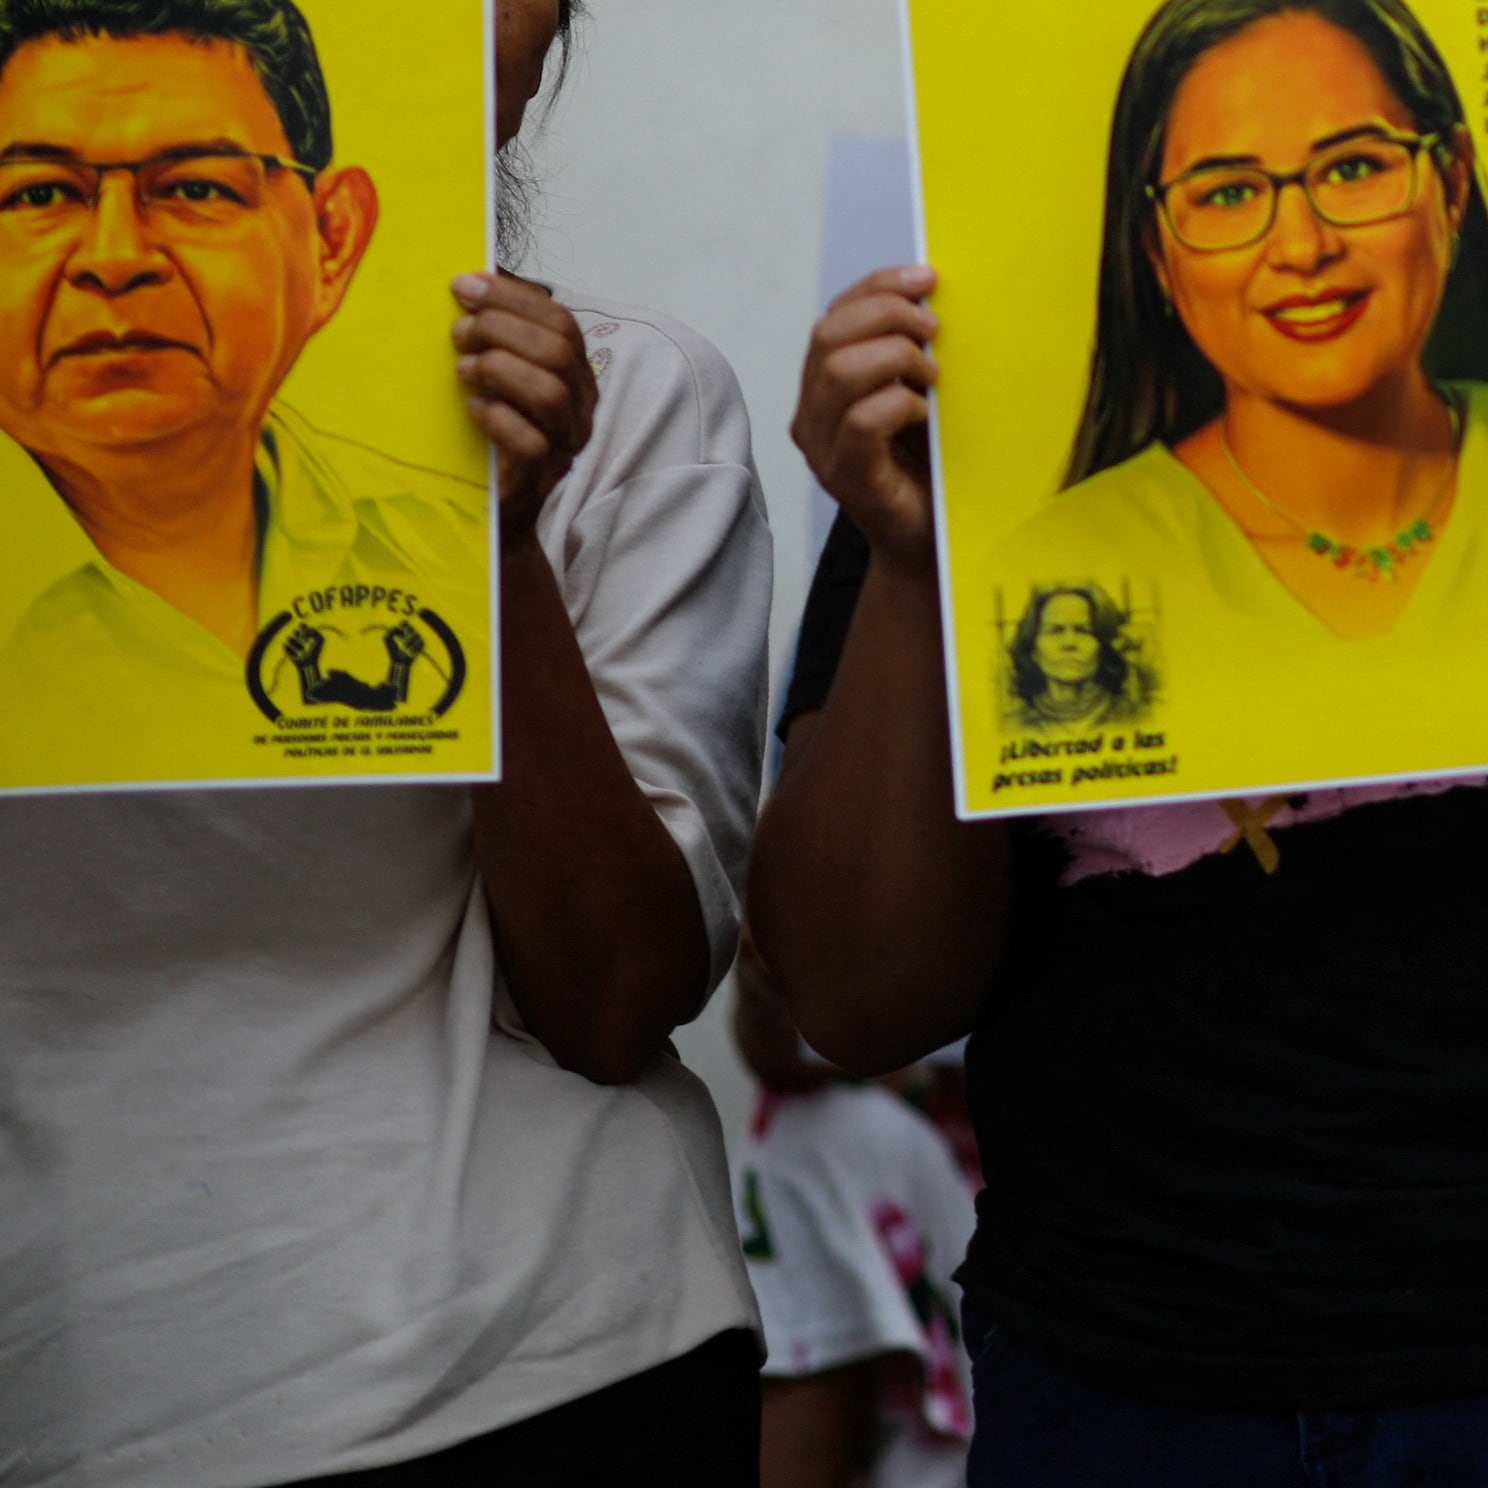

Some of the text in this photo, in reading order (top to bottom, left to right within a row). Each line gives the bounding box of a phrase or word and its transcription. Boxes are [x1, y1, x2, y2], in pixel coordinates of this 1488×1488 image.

[291, 584, 420, 619] COFAPPES
[1111, 735, 1125, 751] a
[1134, 730, 1165, 749] las
